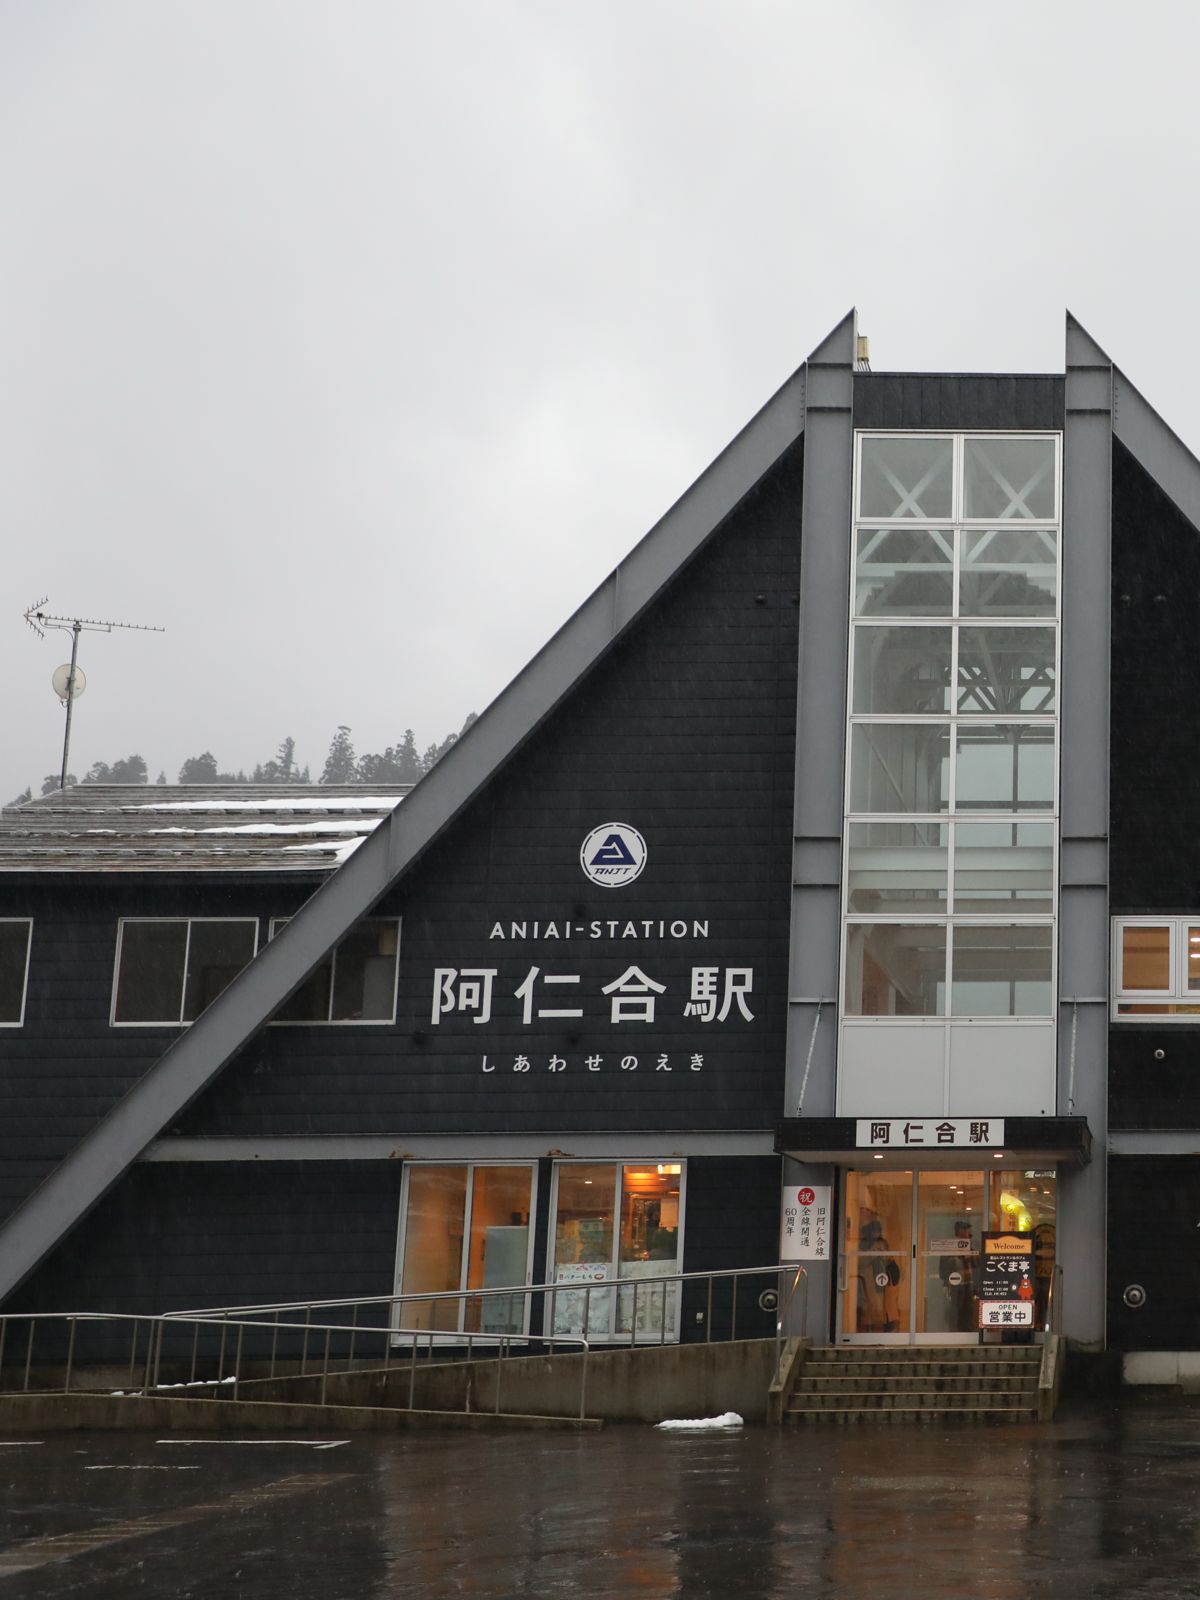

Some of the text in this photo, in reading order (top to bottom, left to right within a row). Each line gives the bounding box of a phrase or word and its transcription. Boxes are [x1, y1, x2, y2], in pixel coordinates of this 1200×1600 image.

[490, 920, 709, 939] ANIAI-STATION
[431, 966, 755, 1025] 阿仁合駅
[481, 1053, 705, 1073] しあわせのえき
[870, 1122, 990, 1144] 阿仁合駅
[799, 1191, 813, 1203] 祝
[800, 1206, 811, 1247] 全線開通
[815, 1207, 826, 1257] 旧阿仁合線
[986, 1261, 1030, 1272] こぐま亭
[989, 1311, 1026, 1323] 営業中
